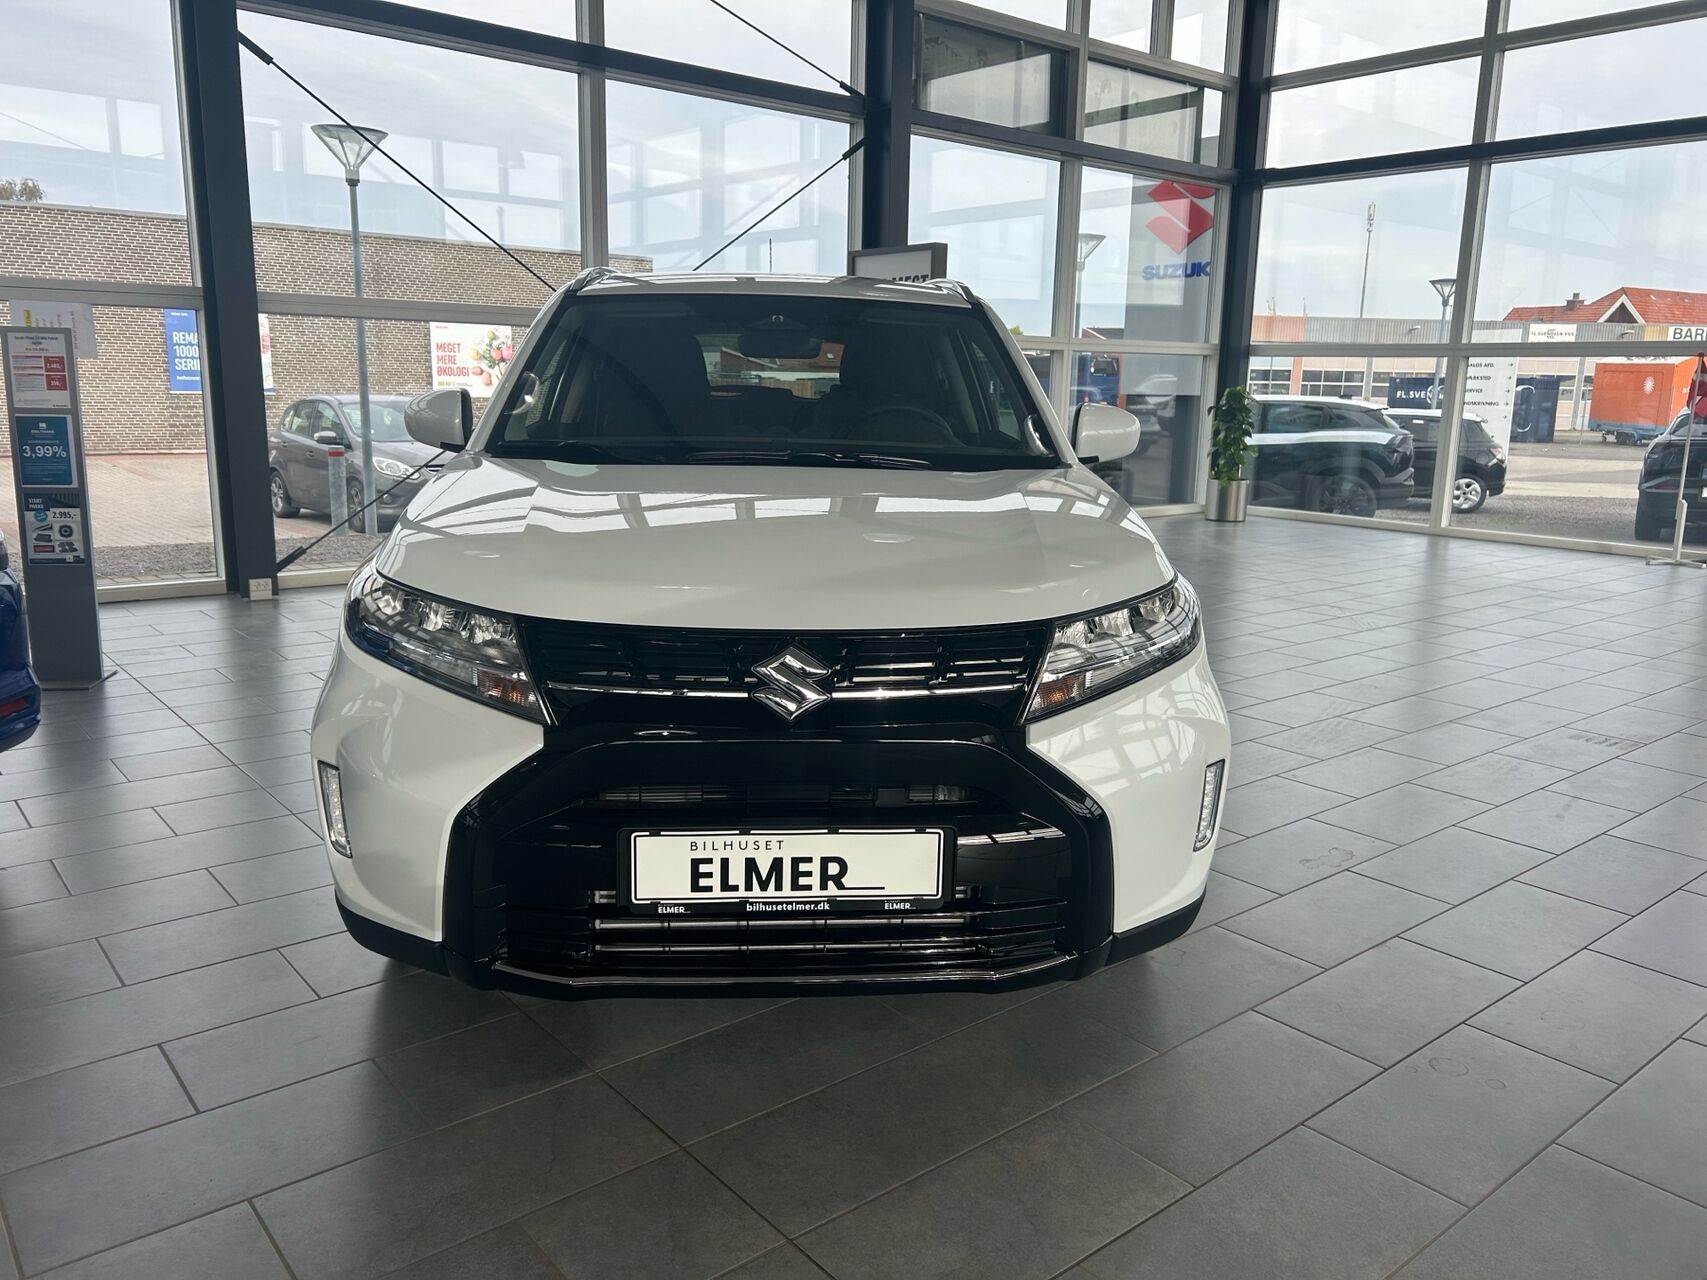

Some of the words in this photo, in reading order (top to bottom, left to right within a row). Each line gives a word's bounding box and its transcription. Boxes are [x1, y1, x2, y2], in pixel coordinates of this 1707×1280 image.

[1142, 261, 1212, 280] SUZUK
[1673, 327, 1707, 340] BAR
[173, 345, 200, 357] 1000
[436, 342, 461, 353] MEGET
[436, 354, 458, 365] MERE
[436, 366, 470, 376] ØKOLOGI
[22, 445, 67, 459] 3,99%
[690, 840, 785, 852] BILHUSET
[690, 856, 852, 893] ELMER
[658, 906, 688, 914] ELMER
[746, 901, 831, 912] bilhusetelmer.dk
[884, 902, 913, 910] ELMER
